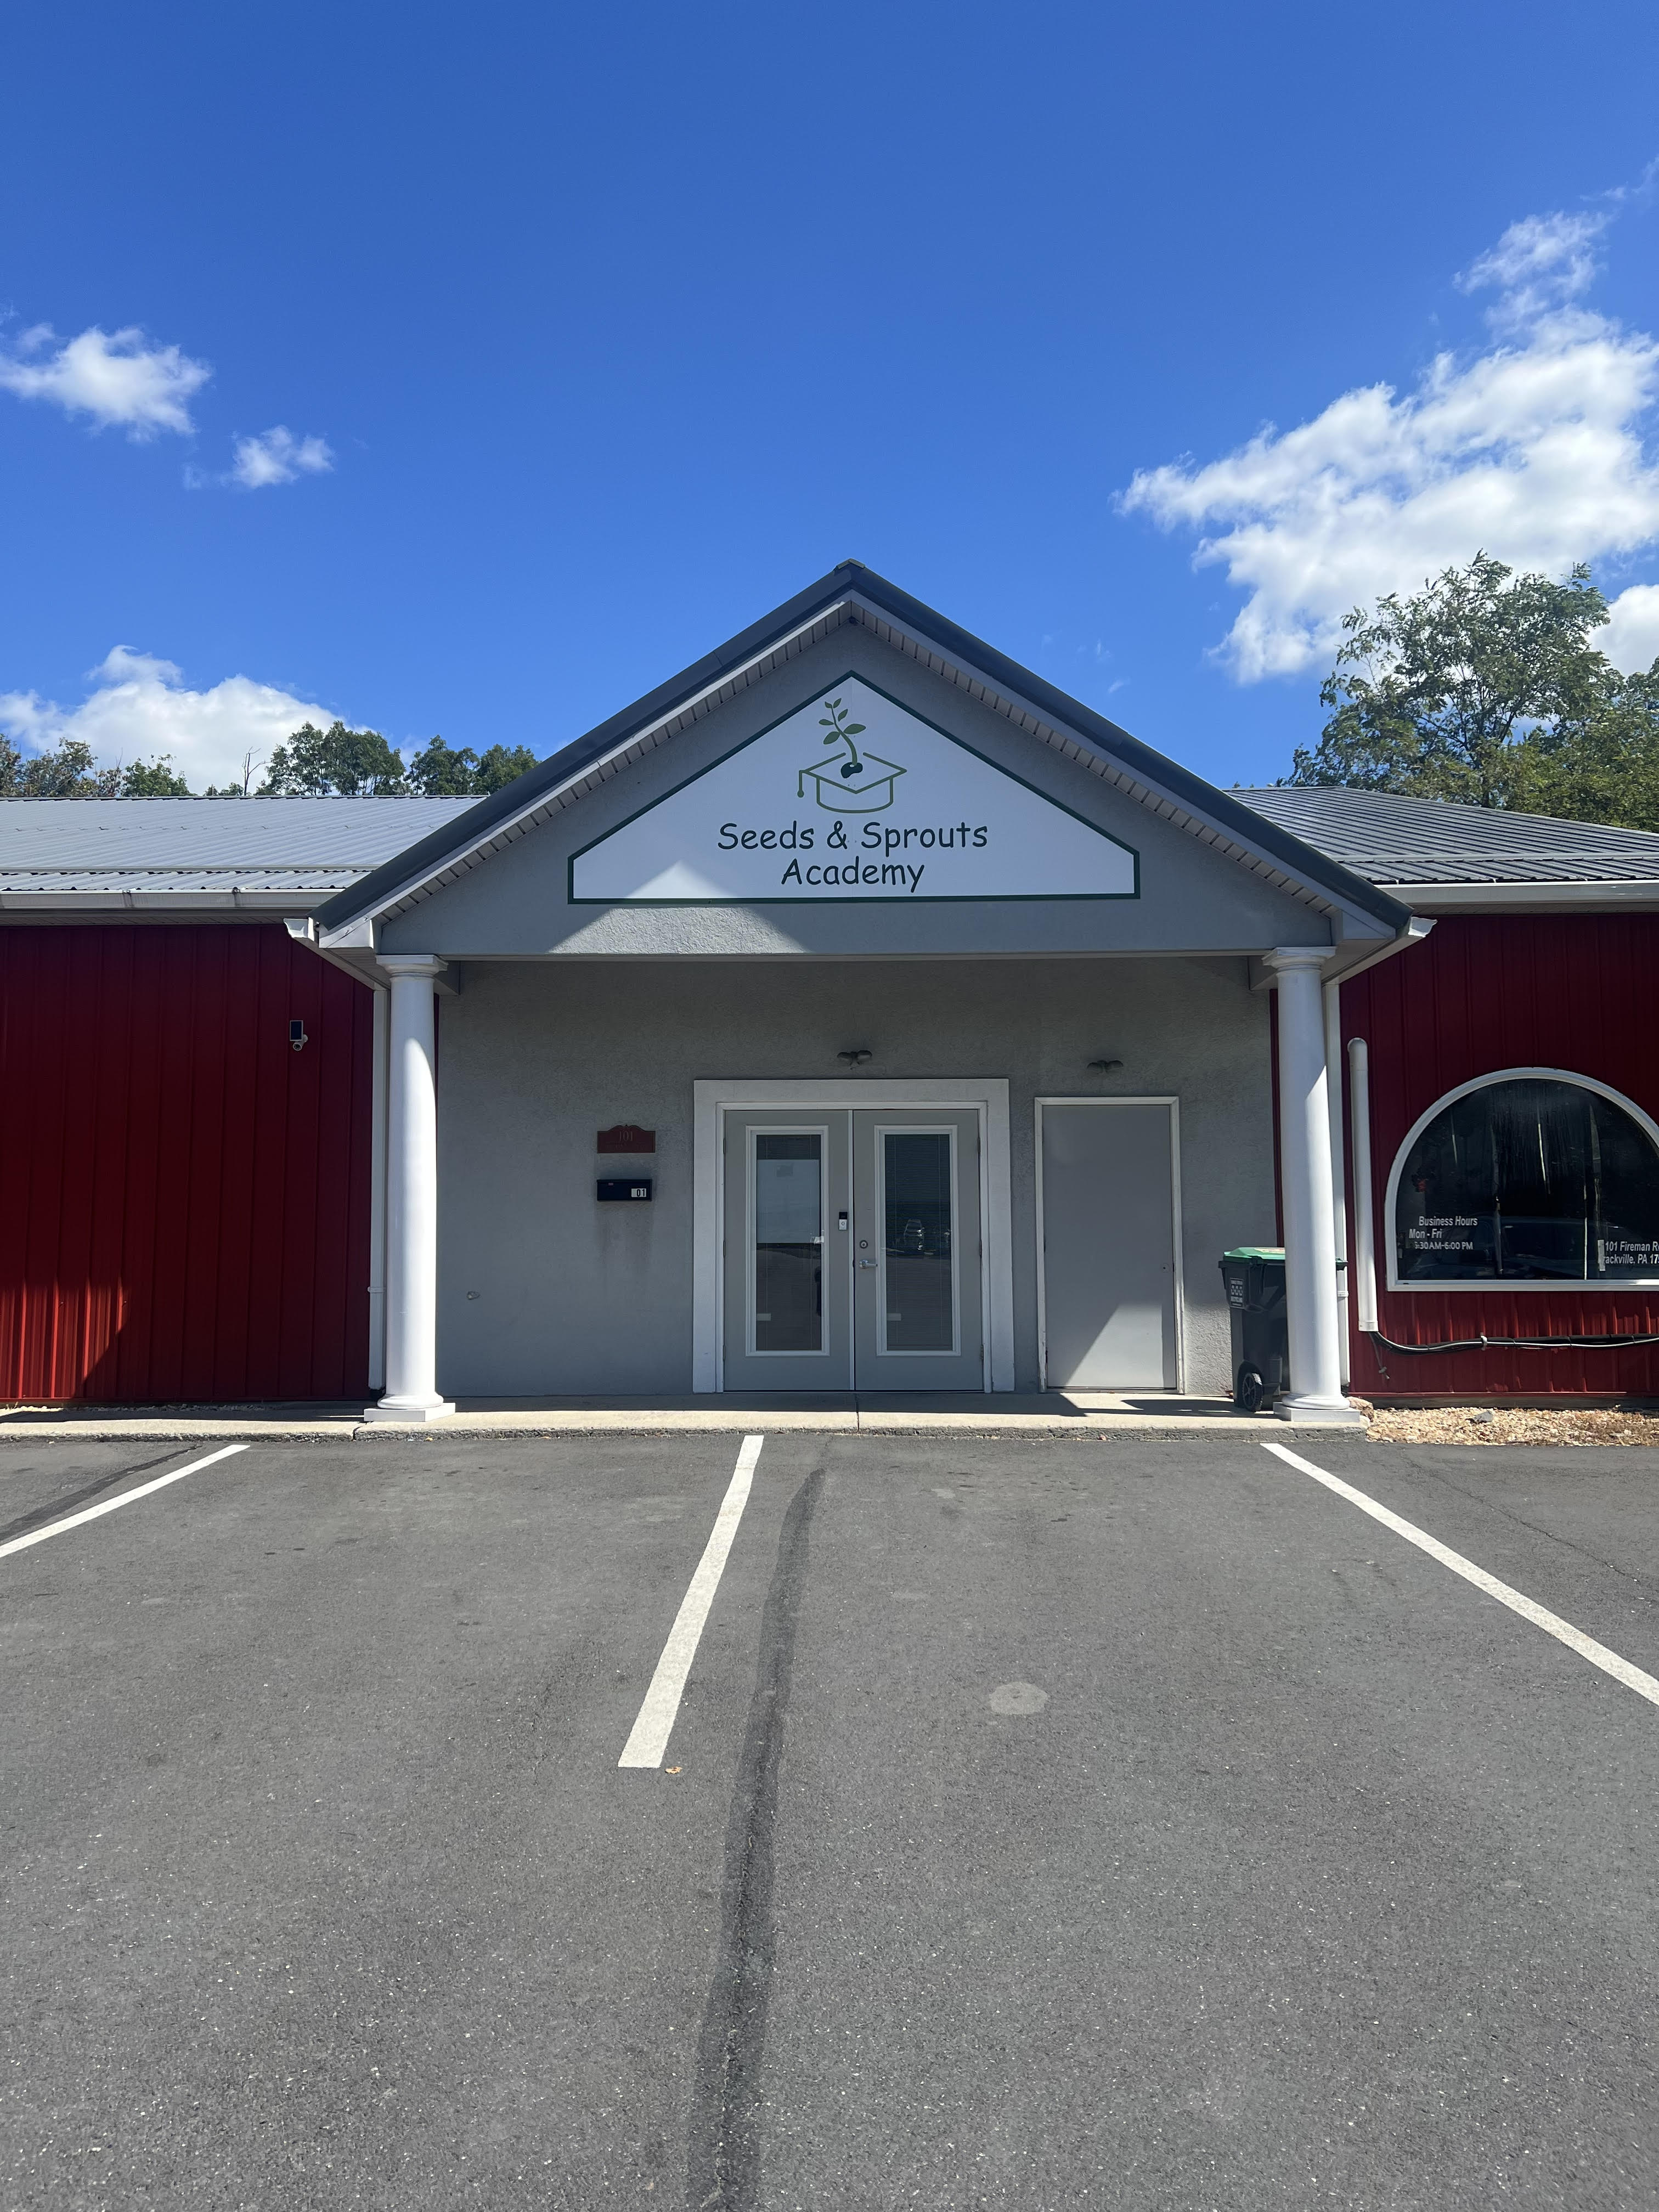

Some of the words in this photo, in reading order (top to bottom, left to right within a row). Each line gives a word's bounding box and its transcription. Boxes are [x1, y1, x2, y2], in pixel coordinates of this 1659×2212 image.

[718, 820, 814, 850] Seeds
[827, 820, 848, 850] &
[861, 821, 988, 857] Sprouts
[781, 856, 925, 893] Academy
[619, 1131, 633, 1142] 101
[1419, 1216, 1454, 1226] Business
[1454, 1216, 1478, 1226] Hours
[1408, 1228, 1425, 1239] Mon
[1431, 1228, 1443, 1239] Fri
[1605, 1241, 1618, 1251] 101
[1620, 1241, 1650, 1251] Fireman
[1652, 1241, 1659, 1251] R
[1637, 1254, 1647, 1264] PA
